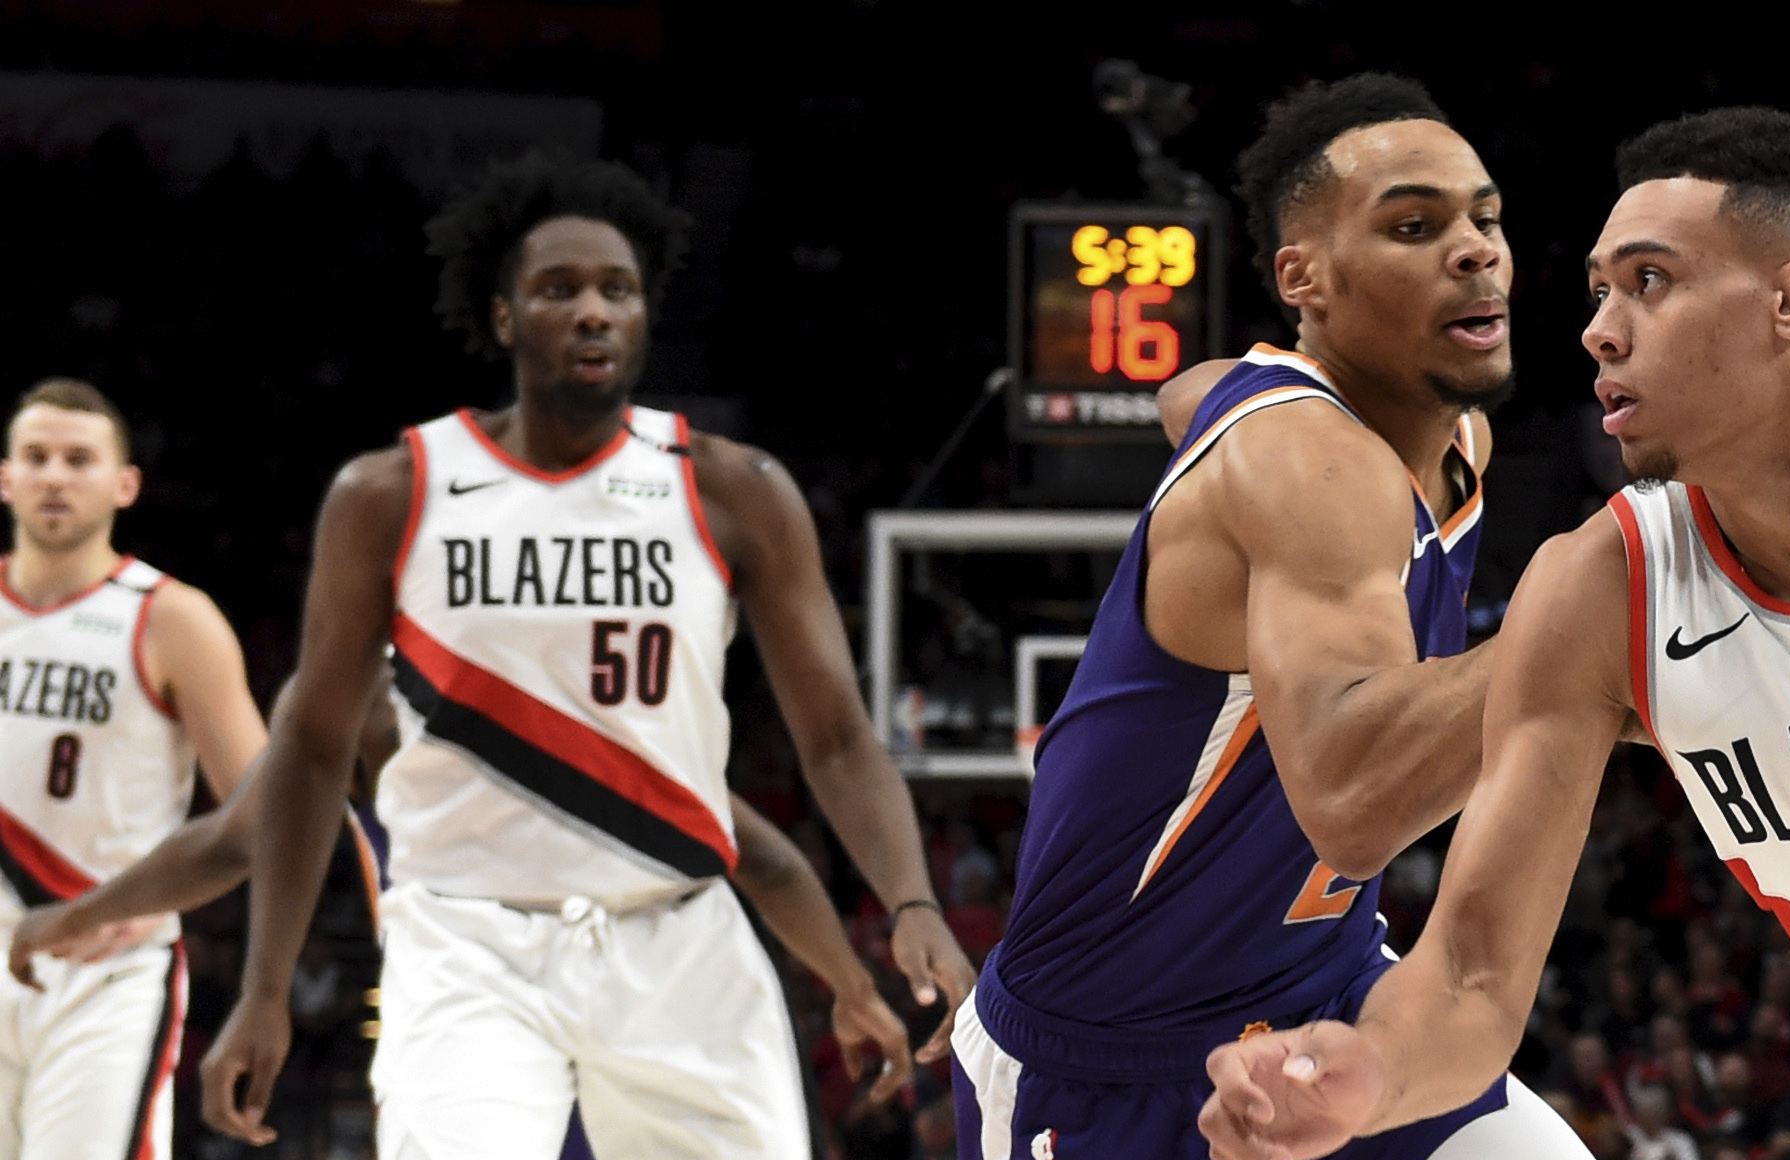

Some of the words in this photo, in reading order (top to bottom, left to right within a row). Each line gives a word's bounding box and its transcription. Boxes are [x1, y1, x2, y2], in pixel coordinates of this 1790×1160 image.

[1072, 225, 1196, 287] 5:39
[1090, 284, 1179, 380] 16
[443, 537, 674, 607] BLAZERS
[591, 618, 674, 706] 50
[47, 732, 82, 799] 8
